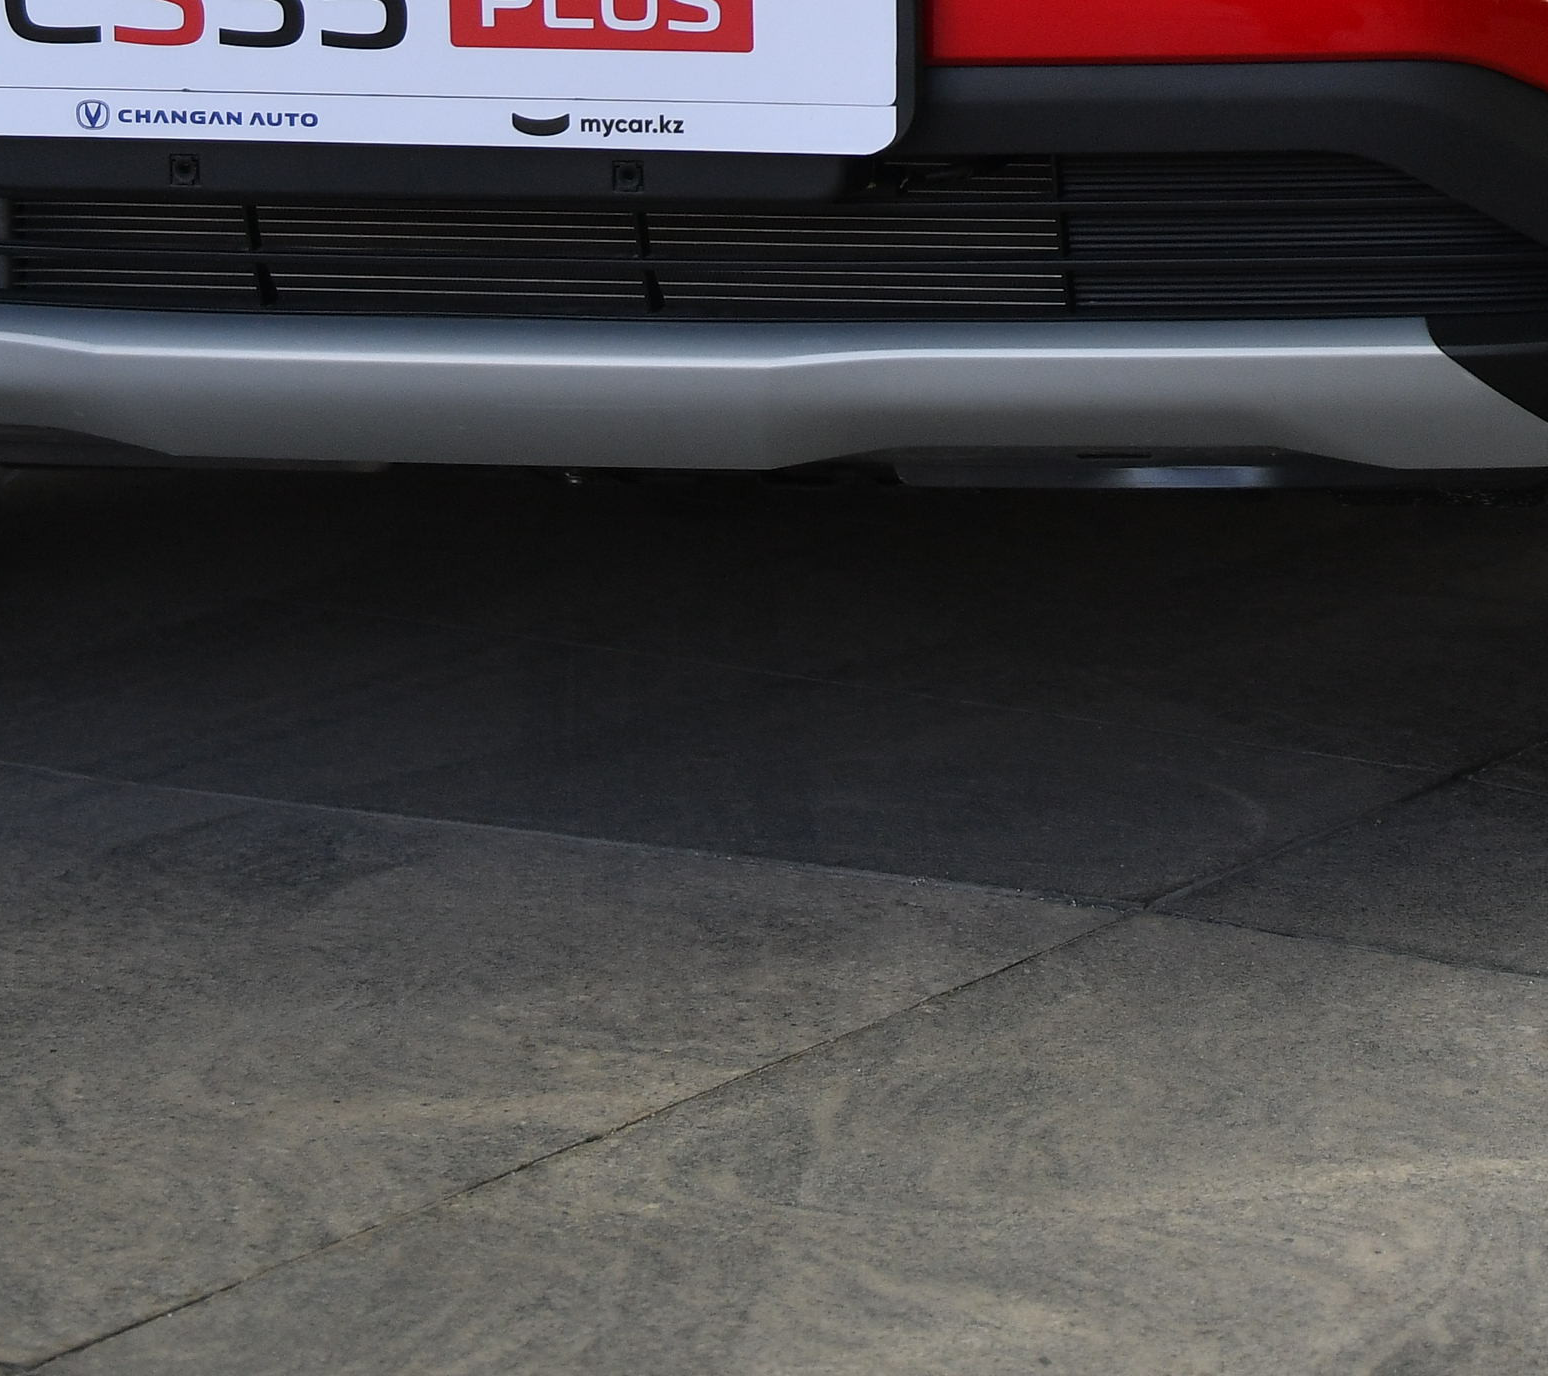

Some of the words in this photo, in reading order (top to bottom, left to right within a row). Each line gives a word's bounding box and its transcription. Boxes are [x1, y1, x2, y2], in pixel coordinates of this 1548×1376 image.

[118, 109, 243, 126] CHANGAN
[249, 112, 319, 127] AUTO
[580, 114, 685, 138] mycar.kz
